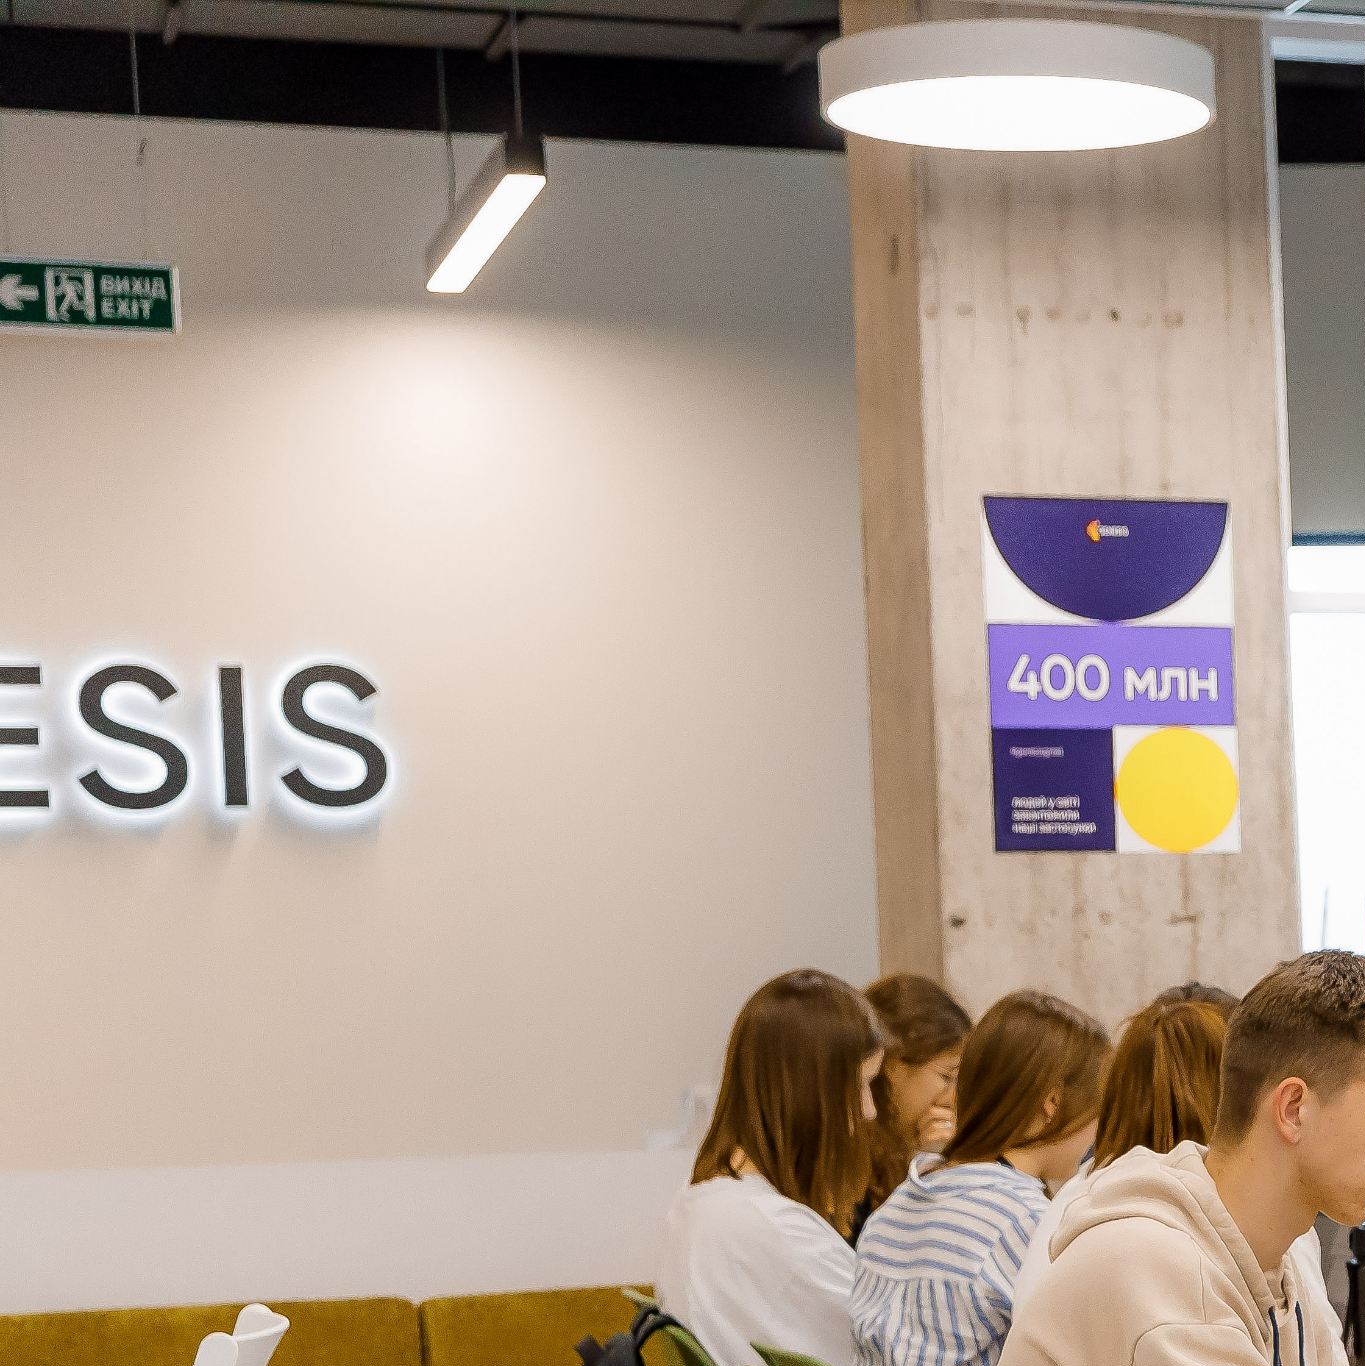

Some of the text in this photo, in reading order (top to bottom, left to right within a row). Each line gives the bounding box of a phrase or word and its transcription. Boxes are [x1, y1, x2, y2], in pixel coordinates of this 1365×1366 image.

[101, 298, 153, 320] EXIT
[1007, 653, 1219, 702] 400 млн
